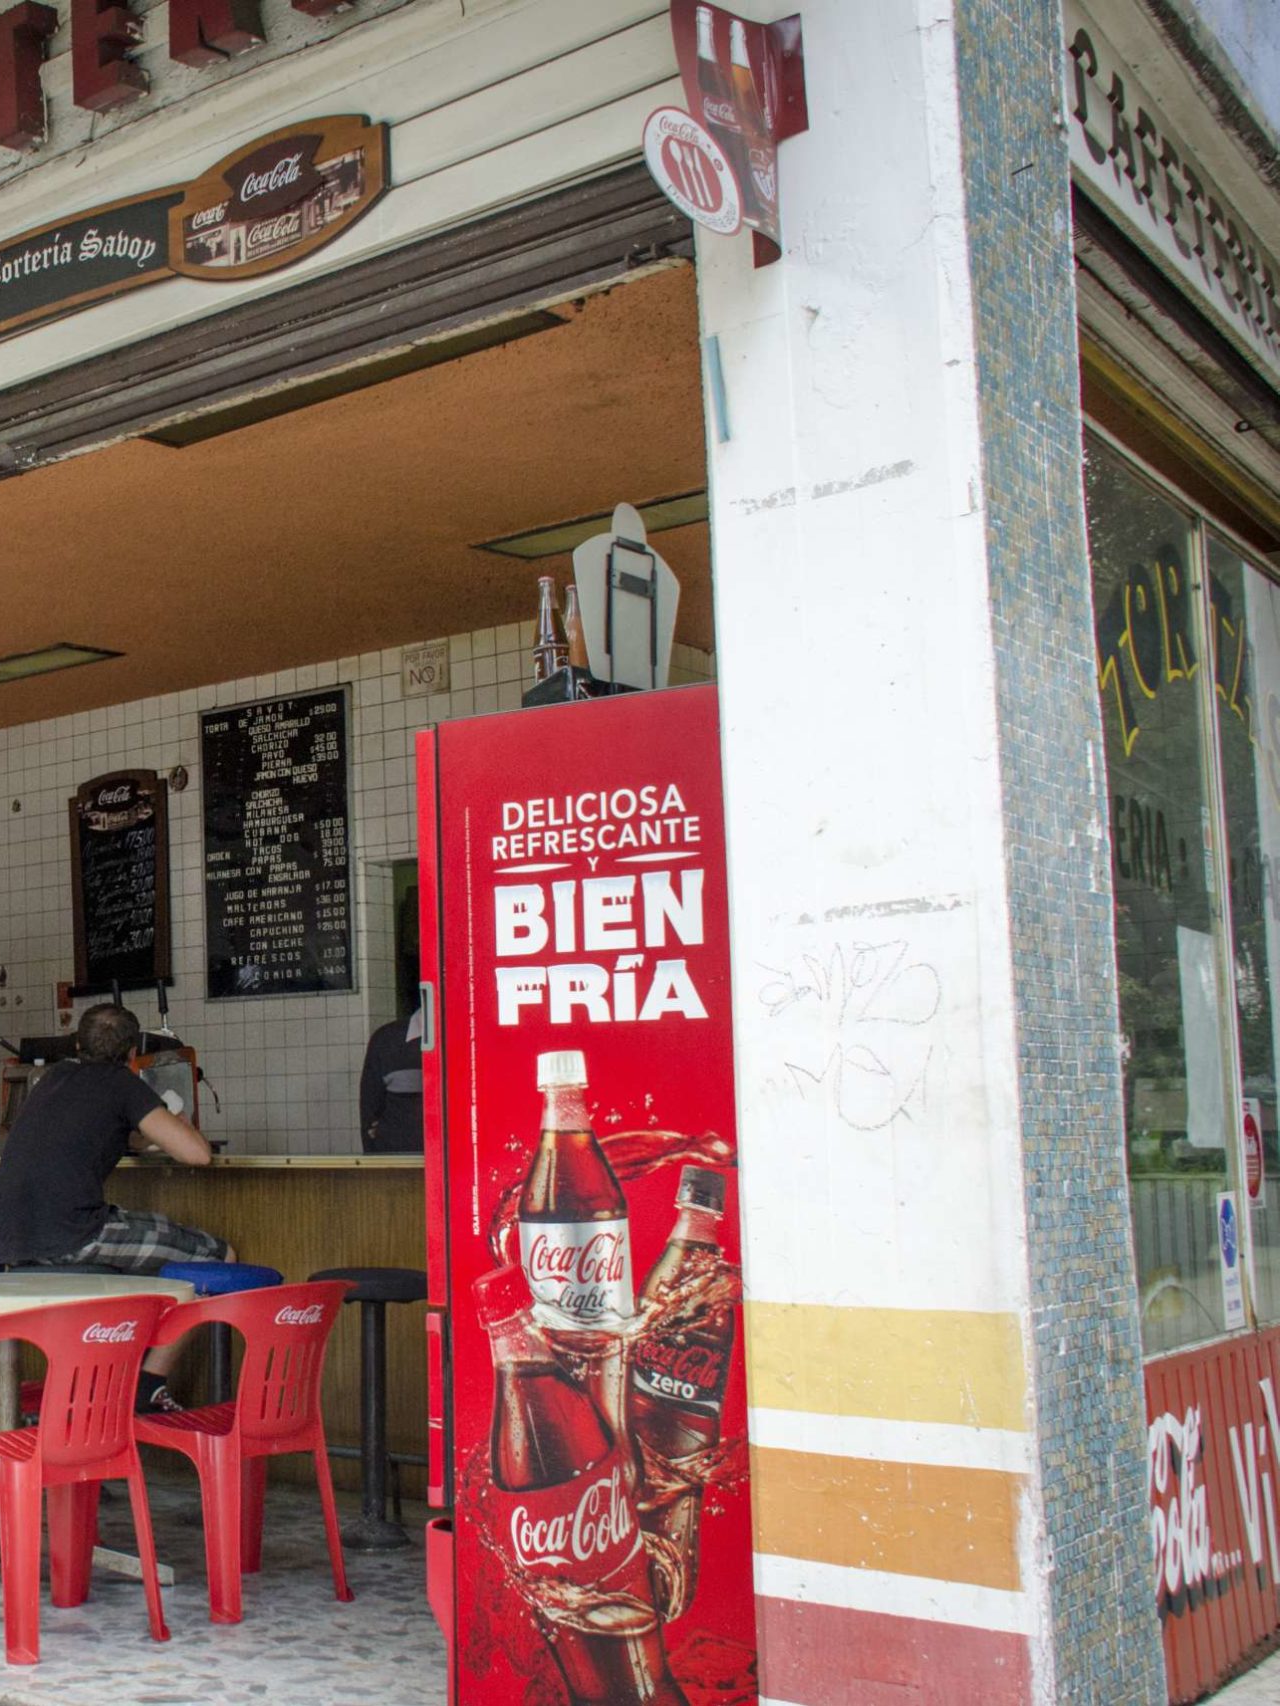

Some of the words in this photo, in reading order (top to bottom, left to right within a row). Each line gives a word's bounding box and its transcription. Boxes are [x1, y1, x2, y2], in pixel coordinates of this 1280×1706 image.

[240, 152, 303, 202] Coca-Cola
[247, 211, 301, 249] Coca-Cola
[205, 721, 229, 735] TORTA
[251, 740, 289, 754] CHORIZO
[261, 750, 285, 761] PAVO
[98, 785, 131, 806] Coca-Cola
[502, 783, 686, 831] DELICIOSA
[492, 815, 702, 861] REFRESCANTE
[587, 856, 600, 873] Y
[494, 868, 705, 957] BIEN
[495, 953, 710, 1026] FRÍA
[530, 1232, 625, 1285] Coca-Cola
[274, 1303, 325, 1325] Coca-Cola
[82, 1320, 138, 1343] Coca-Cola
[650, 1369, 698, 1400] zero
[511, 1465, 634, 1567] Coca-Cola
